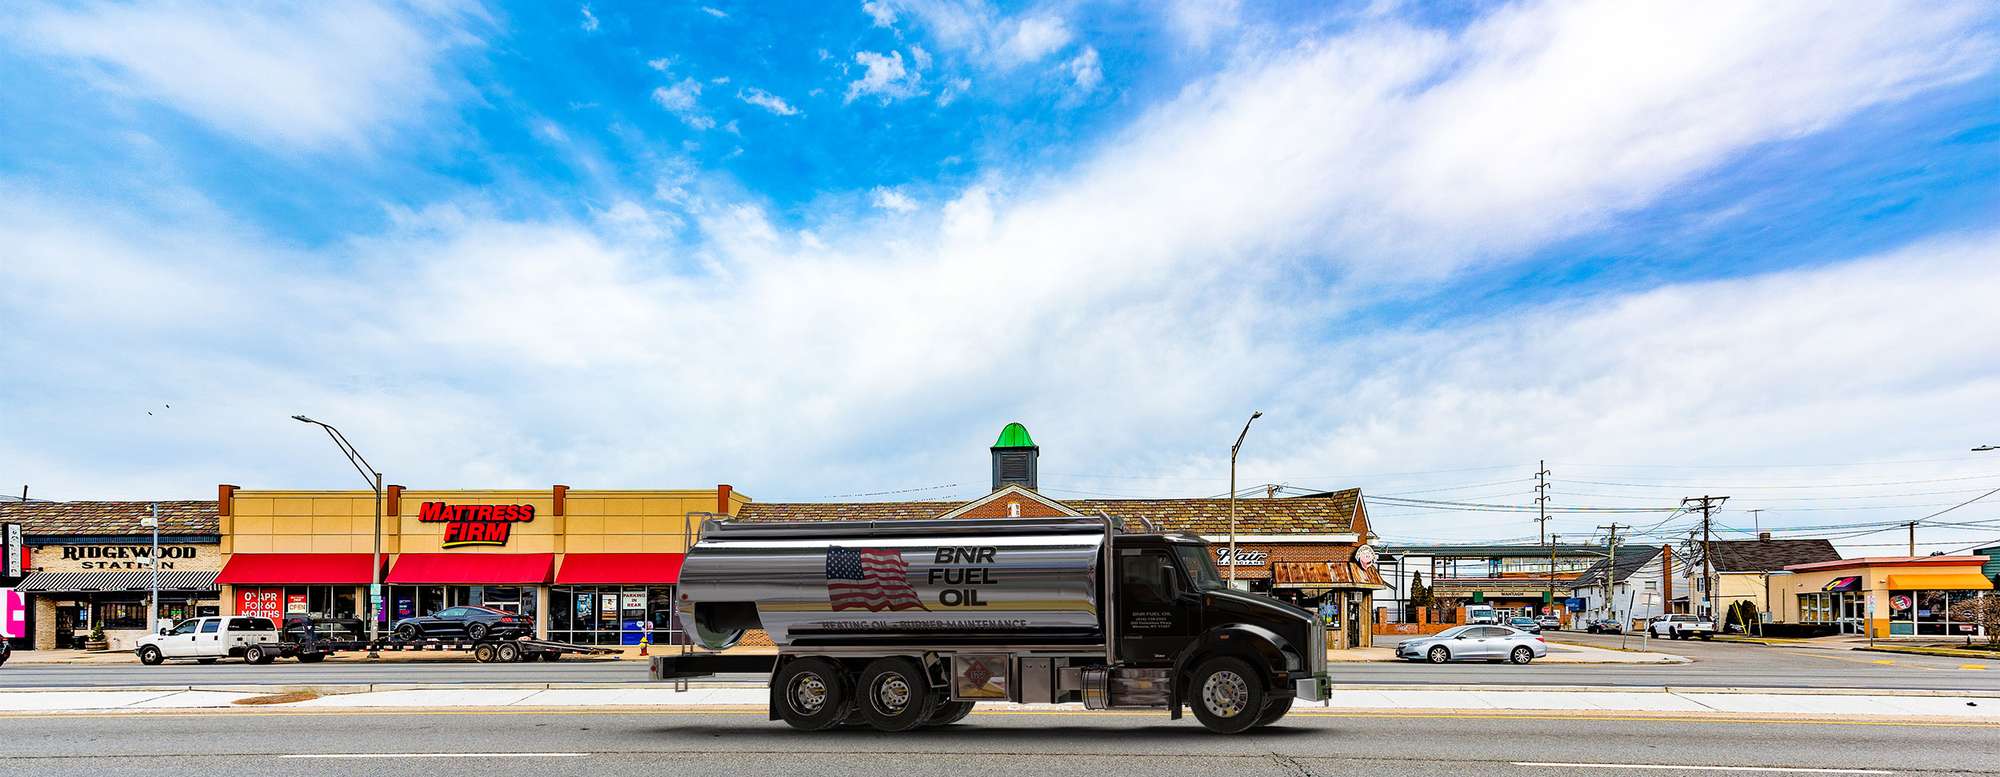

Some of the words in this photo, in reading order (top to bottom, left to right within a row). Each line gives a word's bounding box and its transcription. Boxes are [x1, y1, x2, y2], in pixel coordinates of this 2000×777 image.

[443, 522, 511, 542] FIRM
[62, 546, 197, 560] RIDGEWOOD
[934, 546, 997, 564] BNR
[928, 567, 998, 585] FUEL
[258, 592, 277, 601] APR
[939, 589, 988, 607] OIL
[245, 602, 264, 610] FOR
[823, 620, 869, 630] HEATING
[871, 620, 888, 630] OIL
[946, 619, 1027, 630] MAINTENANCE
